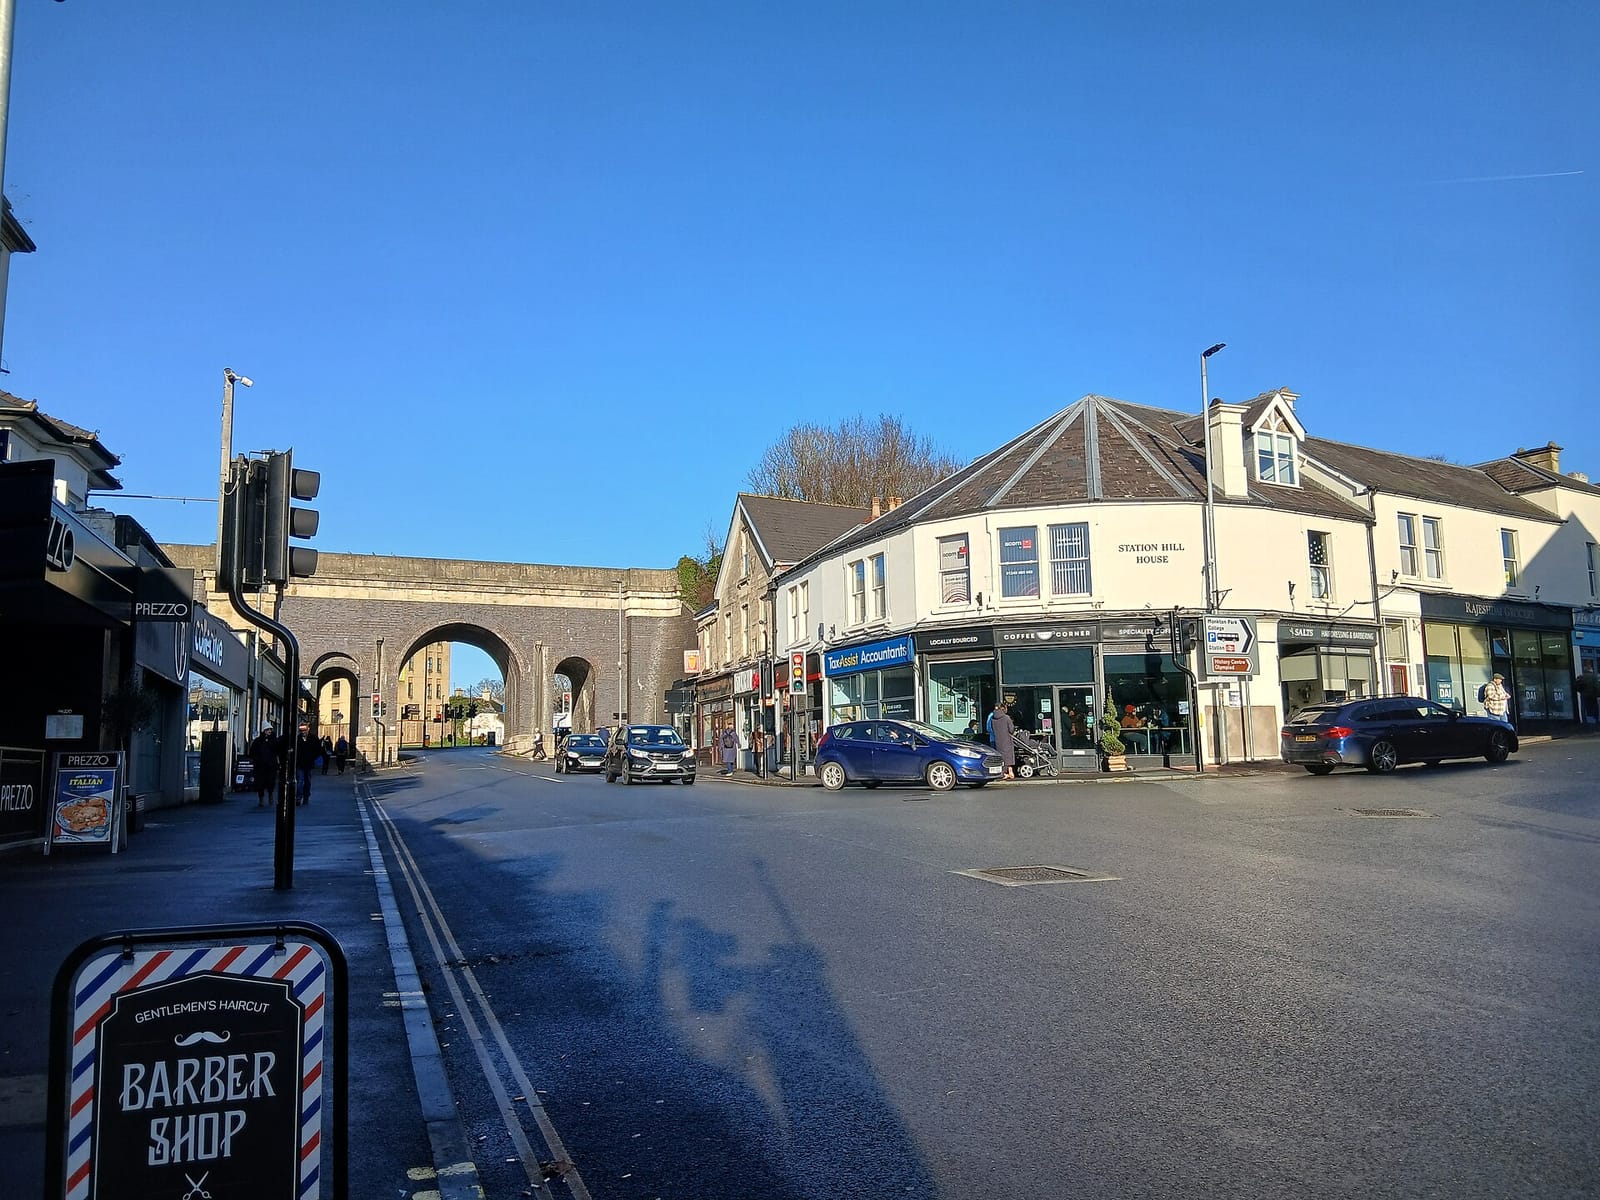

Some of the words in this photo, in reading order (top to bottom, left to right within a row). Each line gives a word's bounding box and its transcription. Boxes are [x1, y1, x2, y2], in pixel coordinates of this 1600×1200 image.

[1118, 543, 1158, 552] STATION
[1161, 543, 1185, 551] HILL
[1136, 555, 1169, 564] HOUSE
[135, 602, 188, 617] PREZZO
[1003, 632, 1036, 640] COFFEE
[1055, 630, 1091, 638] CORNER
[1294, 628, 1314, 637] SALTS
[929, 637, 952, 647] LOCALLY
[952, 636, 978, 645] SOURCED
[827, 654, 859, 670] TaxAssist
[860, 643, 908, 664] Accountants
[68, 755, 110, 766] PREZZO
[68, 778, 104, 786] ITALIAN
[0, 784, 34, 811] PREZZO
[135, 1000, 217, 1024] GENTLEMEN'S
[218, 1000, 270, 1014] HAIRCUT
[118, 1051, 276, 1111] BARBER
[147, 1110, 247, 1166] SHOP
